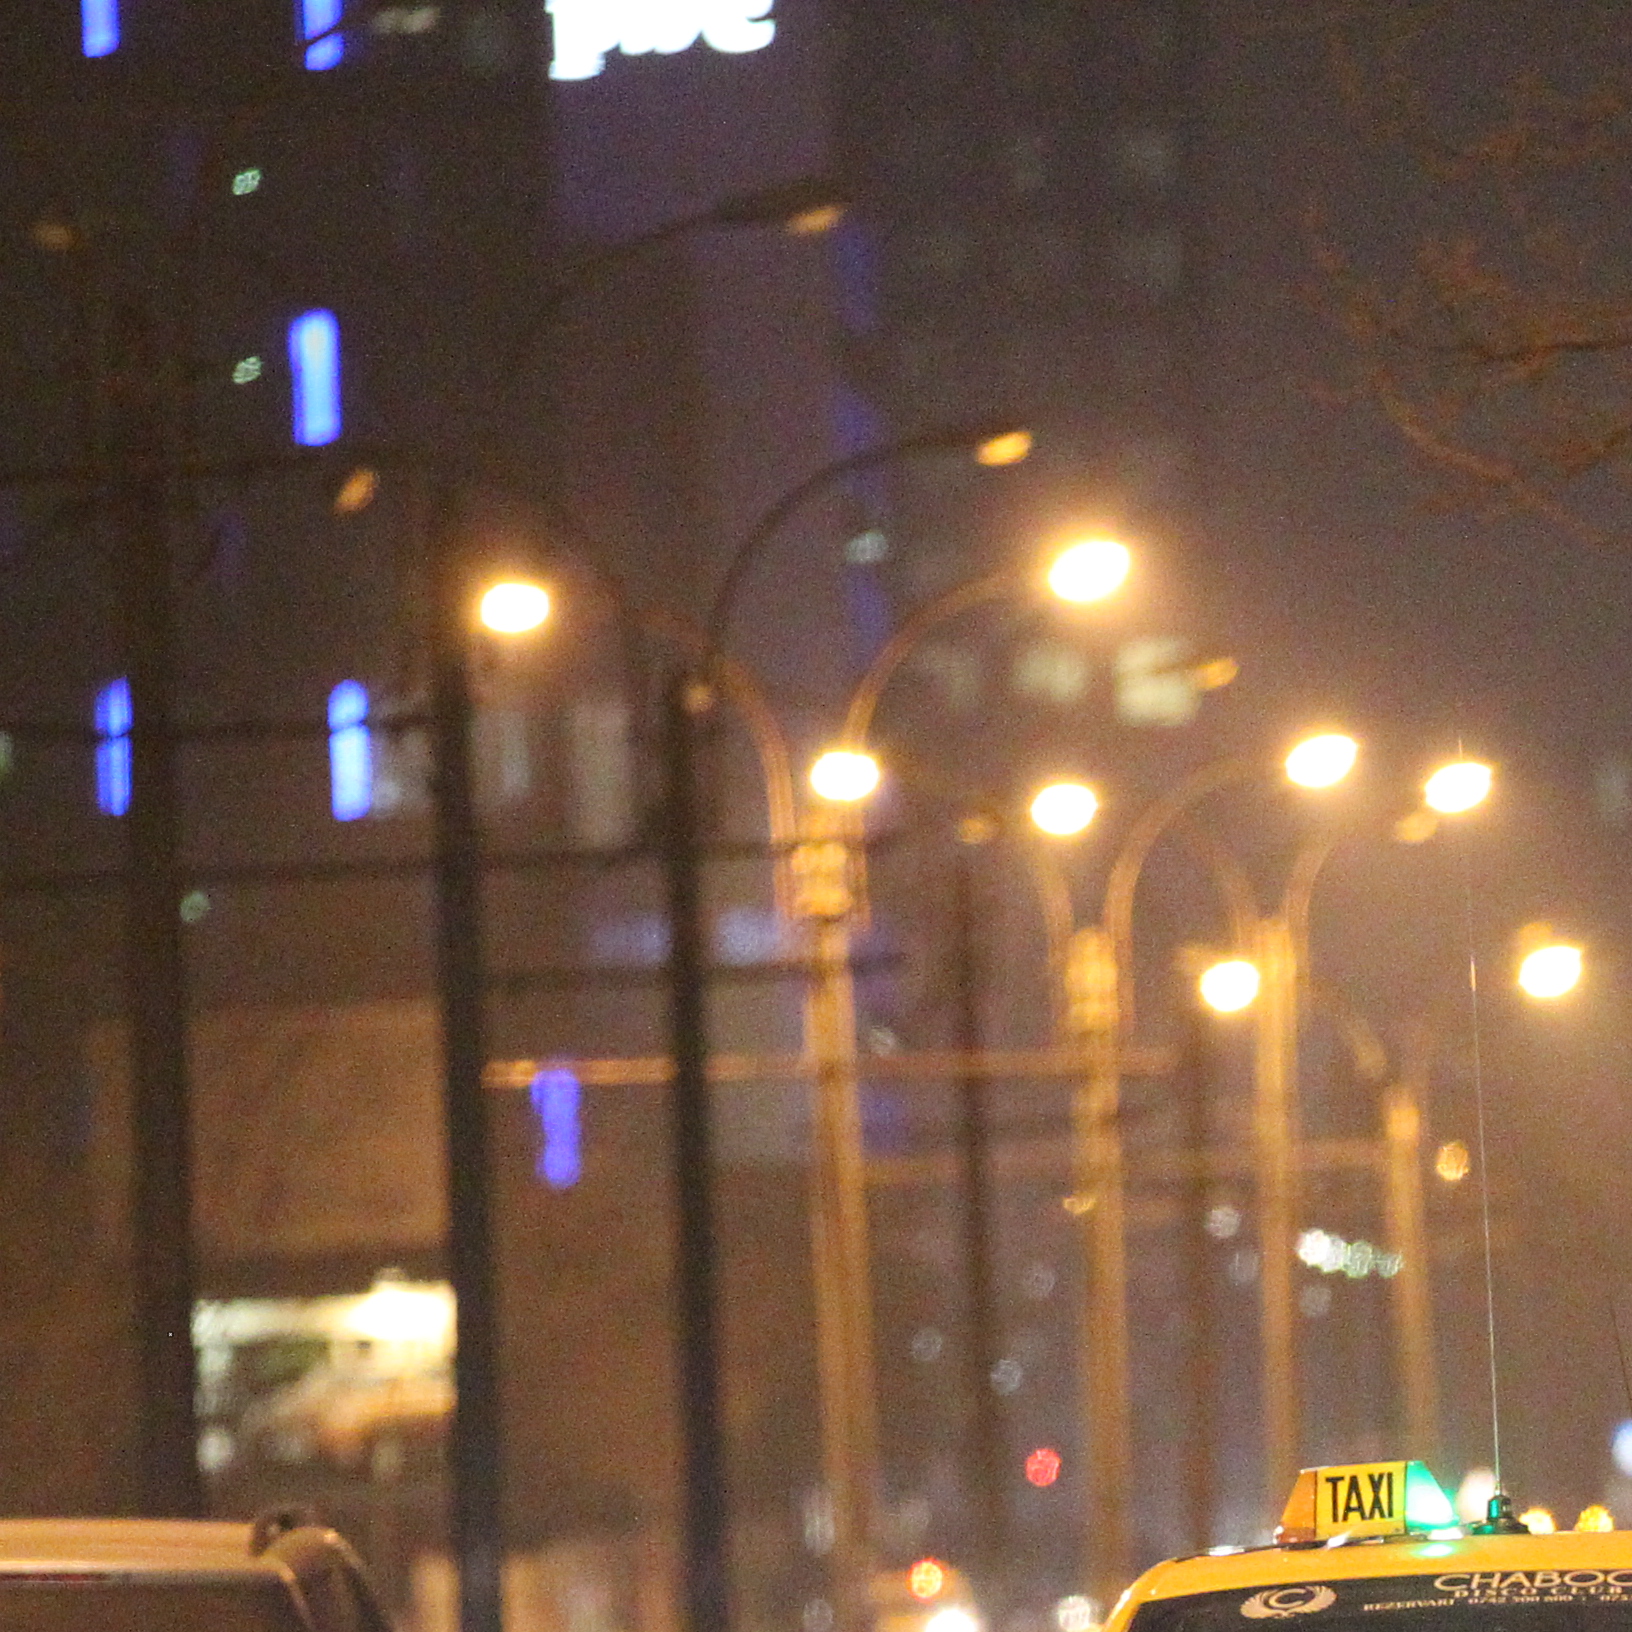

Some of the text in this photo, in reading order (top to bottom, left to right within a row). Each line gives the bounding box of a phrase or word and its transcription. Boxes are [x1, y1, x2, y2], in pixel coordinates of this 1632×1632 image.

[1324, 1472, 1394, 1524] TAXI
[1454, 1586, 1624, 1599] DISCO CLUB
